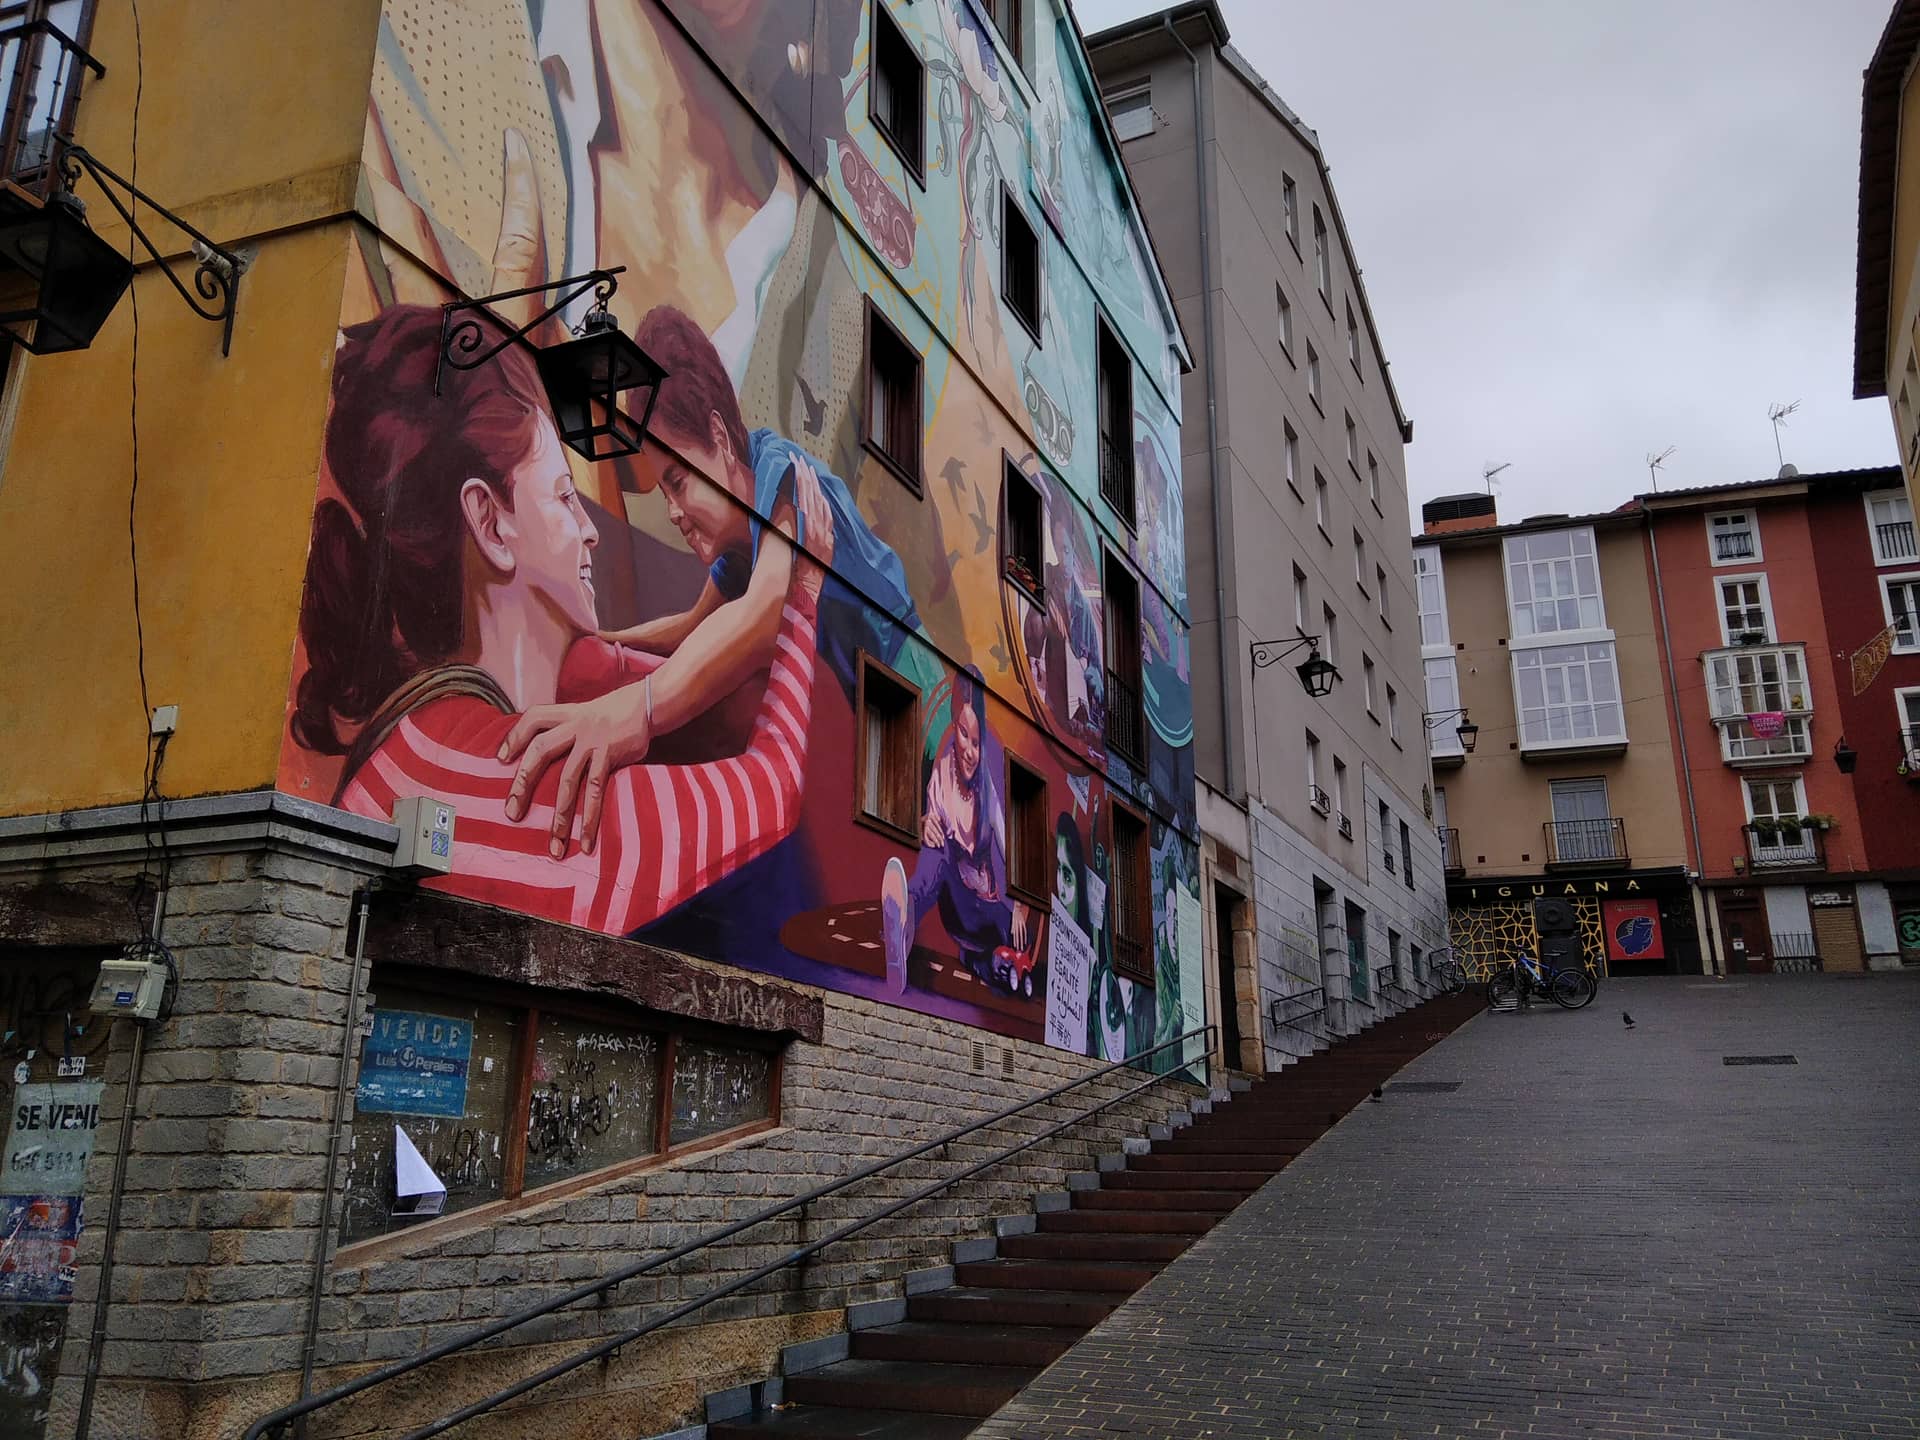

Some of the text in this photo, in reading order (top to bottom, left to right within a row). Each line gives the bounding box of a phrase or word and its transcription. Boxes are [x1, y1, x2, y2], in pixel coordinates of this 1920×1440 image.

[1472, 879, 1641, 899] IGUANA
[381, 1018, 461, 1048] VENDE
[16, 1105, 42, 1130] SE
